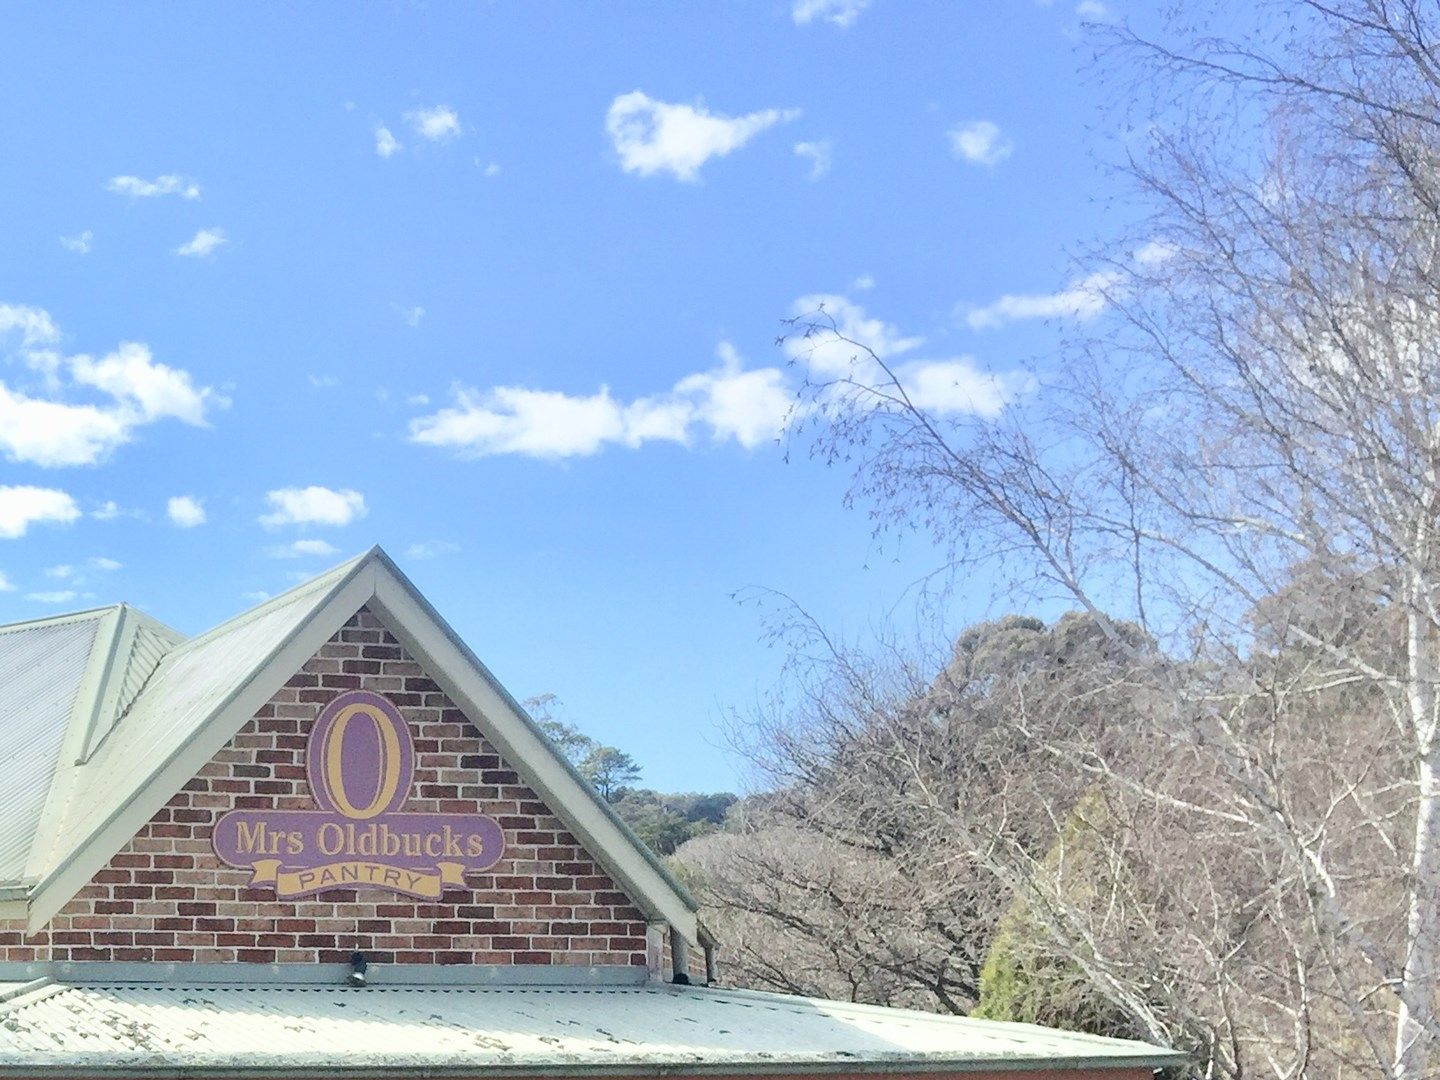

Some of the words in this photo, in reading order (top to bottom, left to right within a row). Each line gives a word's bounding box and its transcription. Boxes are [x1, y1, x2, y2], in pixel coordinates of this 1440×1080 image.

[236, 821, 304, 854] Mrs
[317, 822, 483, 858] Oldbucks
[299, 865, 422, 890] PANTRY
